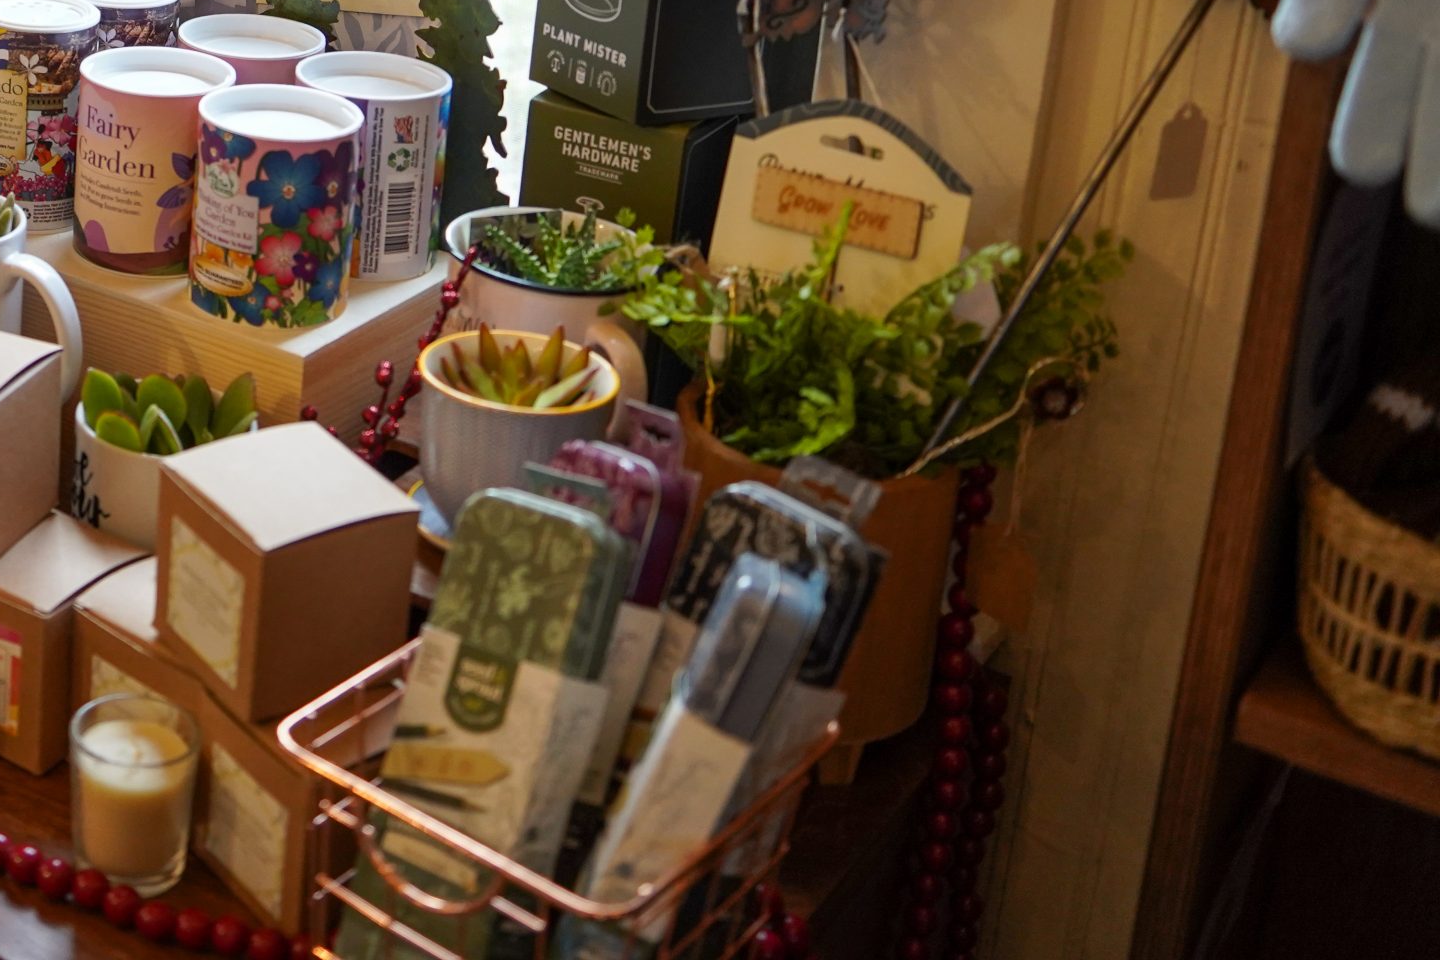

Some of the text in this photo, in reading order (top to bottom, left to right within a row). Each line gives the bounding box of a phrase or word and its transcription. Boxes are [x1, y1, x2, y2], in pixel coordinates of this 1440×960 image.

[542, 22, 627, 68] PLANT MISTER
[0, 95, 24, 108] Garden
[86, 104, 141, 150] Fairy
[554, 125, 652, 161] GENTLEMEN'S
[78, 135, 156, 179] Garden
[562, 141, 641, 173] HARDWARE
[235, 205, 255, 219] You
